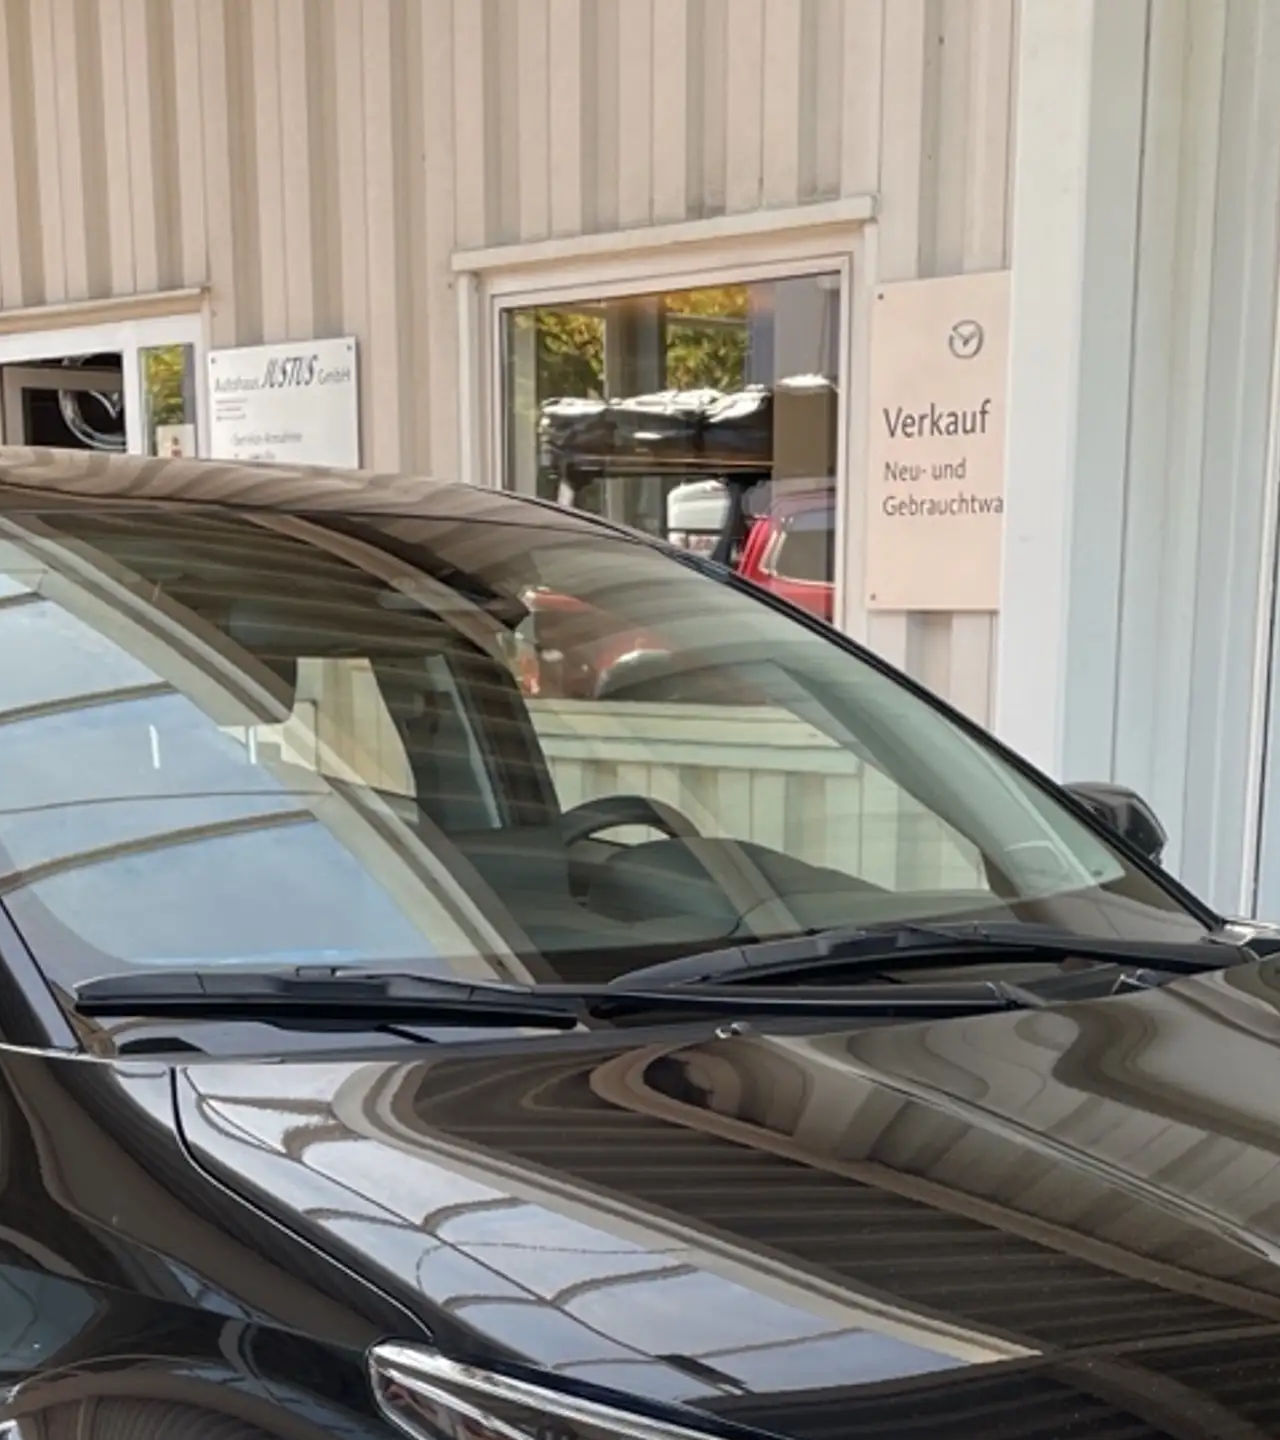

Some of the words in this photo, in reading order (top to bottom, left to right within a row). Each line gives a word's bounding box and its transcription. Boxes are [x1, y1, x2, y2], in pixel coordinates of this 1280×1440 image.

[261, 354, 319, 388] JUSTUS
[883, 398, 991, 439] Verkauf
[884, 461, 926, 481] Neu-
[931, 457, 967, 480] und
[882, 493, 1004, 516] Gebrauchtwa
